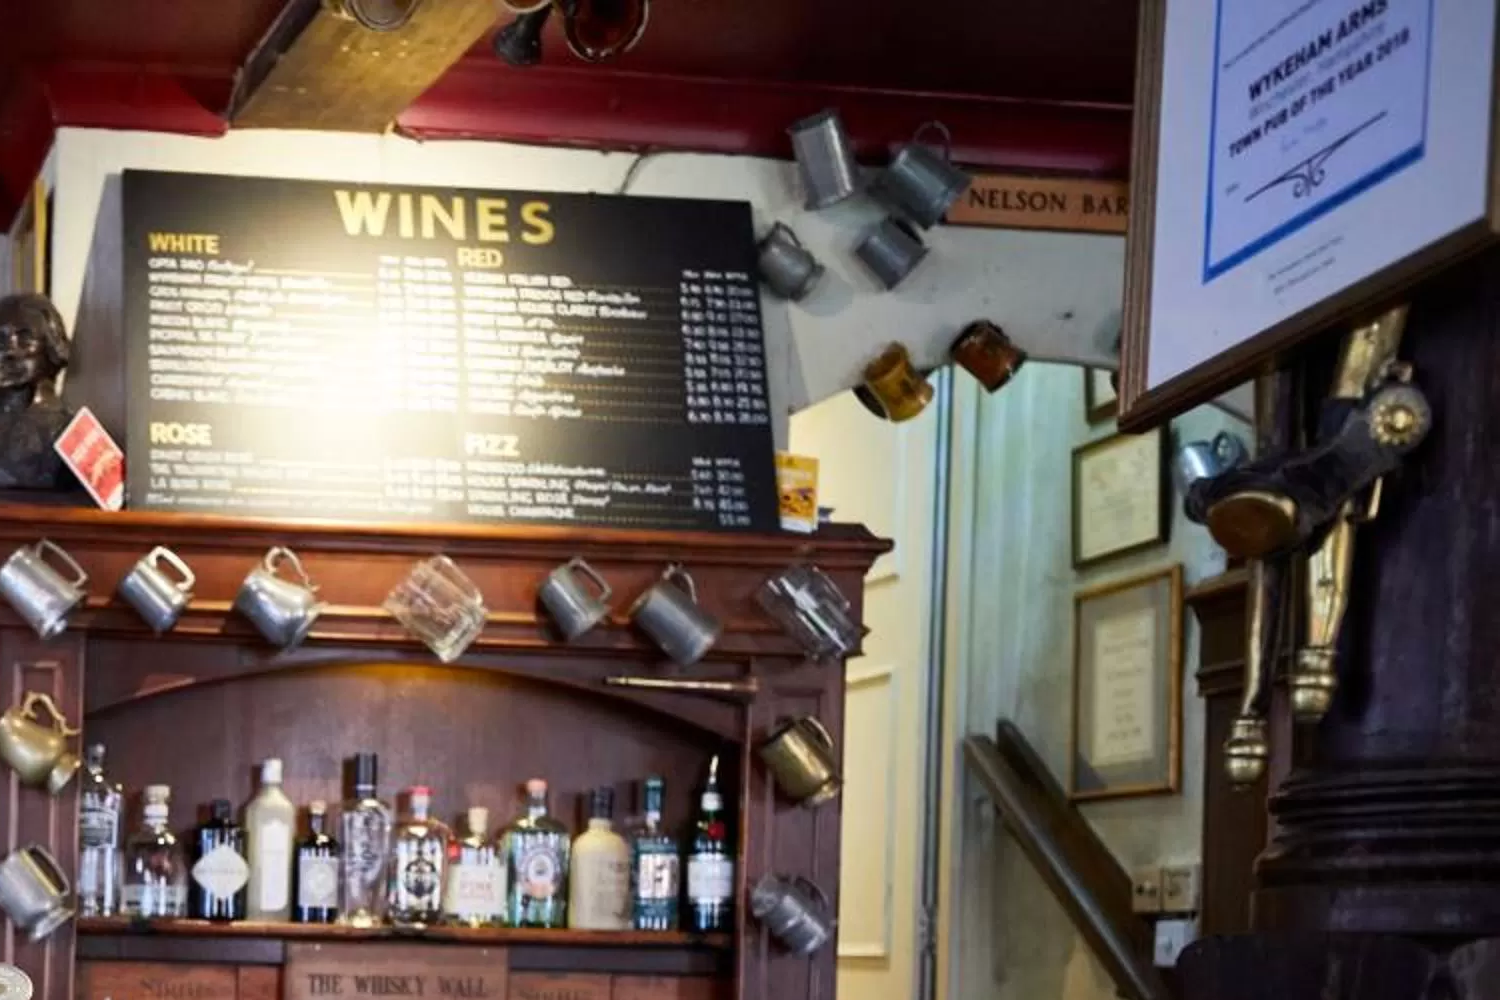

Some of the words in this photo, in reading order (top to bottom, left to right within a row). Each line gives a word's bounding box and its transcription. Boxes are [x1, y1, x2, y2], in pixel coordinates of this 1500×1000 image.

[1248, 28, 1332, 101] WYKEHAM
[1336, 0, 1388, 44] ARMS
[1229, 125, 1262, 158] TOWN
[1264, 108, 1288, 136] PUB
[1290, 94, 1307, 118] OF
[1309, 76, 1335, 105] THE
[1338, 51, 1373, 87] YEAR
[969, 188, 1067, 212] NELSON
[1082, 193, 1128, 216] BAR
[334, 190, 556, 245] WINES
[148, 232, 220, 254] WHITE
[457, 248, 504, 268] RED
[150, 422, 212, 445] ROSE
[465, 432, 520, 457] FIZZ
[308, 974, 343, 995] THE
[355, 975, 427, 997] WHISKY
[438, 976, 487, 998] WALL
